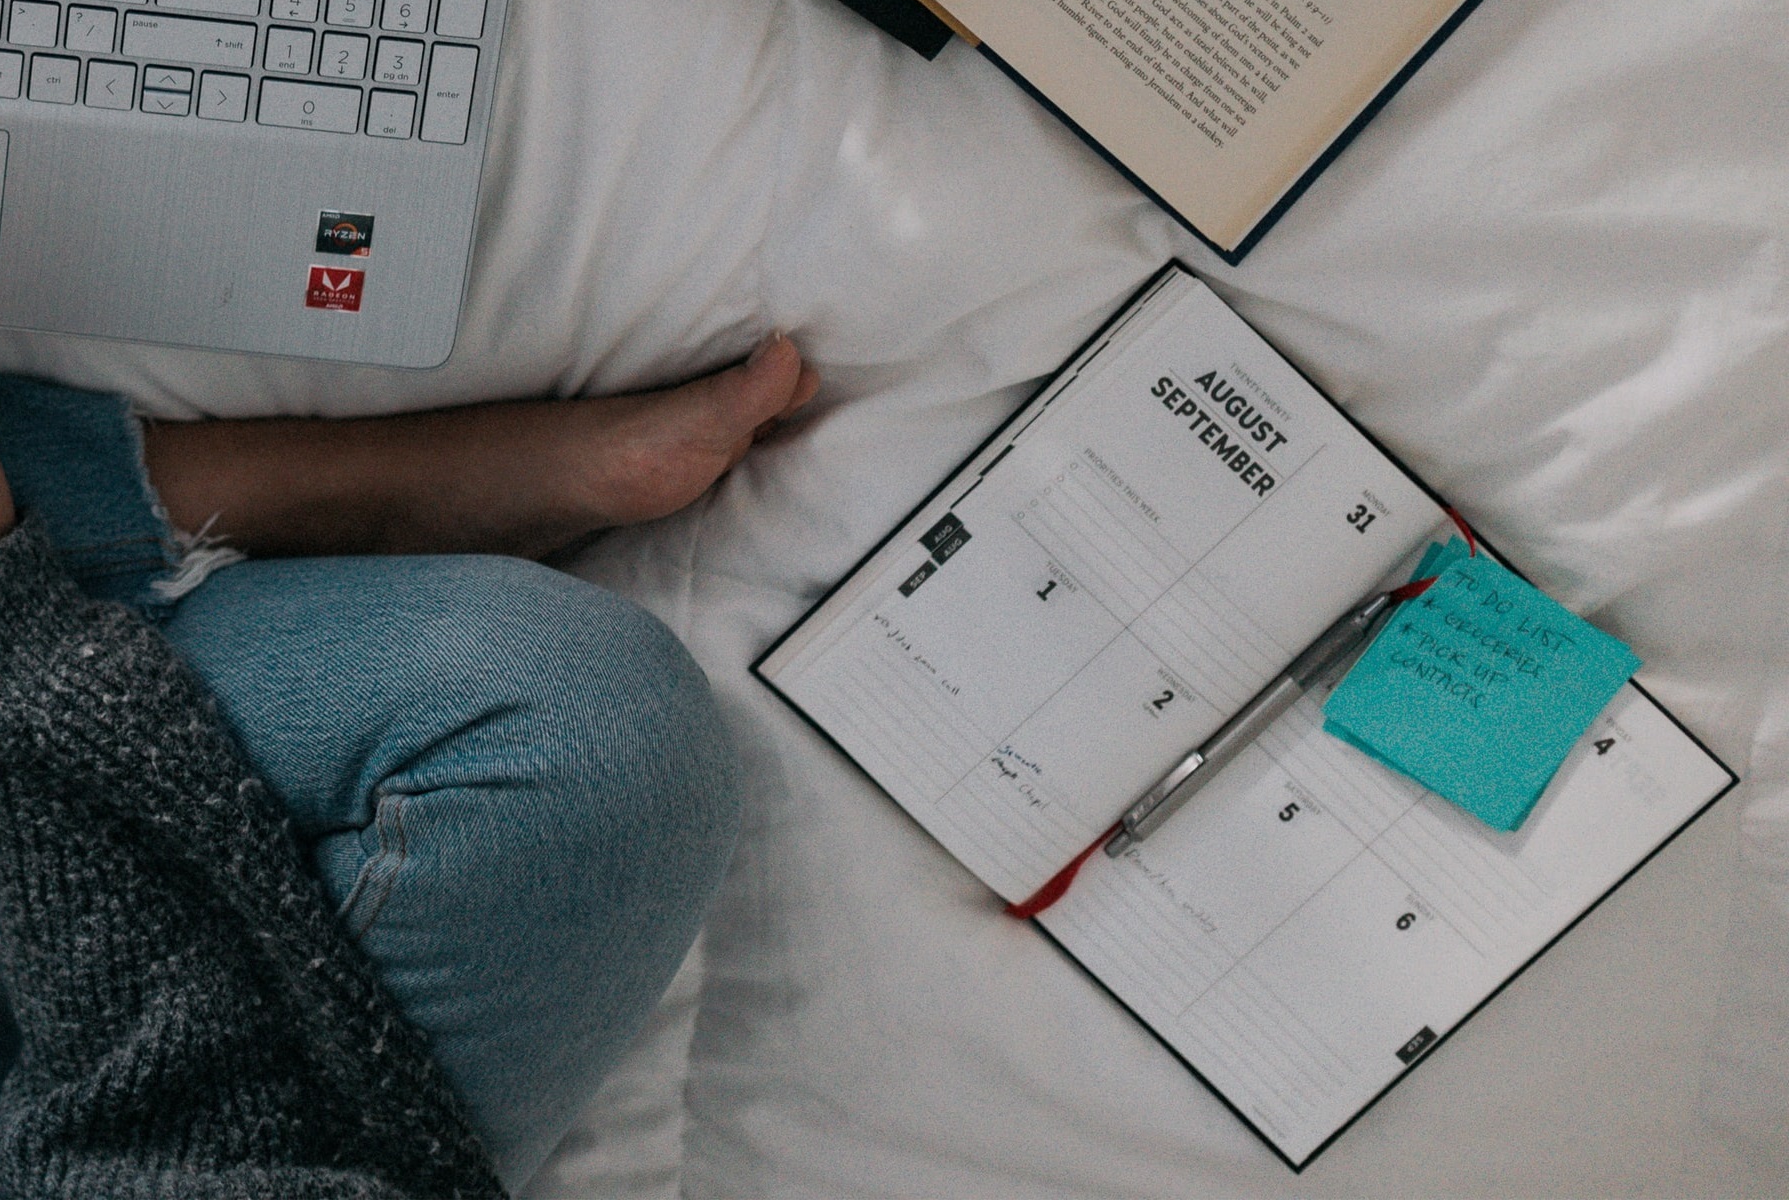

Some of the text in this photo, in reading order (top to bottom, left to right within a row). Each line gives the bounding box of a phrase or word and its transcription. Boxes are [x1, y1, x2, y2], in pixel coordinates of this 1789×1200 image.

[132, 19, 159, 29] pause
[224, 41, 244, 50] shift
[1084, 23, 1109, 49] figure,
[436, 91, 460, 99] enter
[382, 126, 397, 134] del
[324, 228, 366, 240] RYZEN
[313, 291, 356, 299] RADEON
[1227, 361, 1292, 423] TWENTY TWENTY
[1192, 370, 1288, 453] AUGUST
[1149, 376, 1275, 498] SEPTEMBER
[1345, 503, 1376, 535] 31
[1035, 579, 1057, 602] 1
[1482, 588, 1515, 618] DO
[1151, 689, 1175, 712] 2
[1592, 737, 1616, 757] 4
[1277, 802, 1300, 823] 5
[1394, 912, 1417, 932] 6
